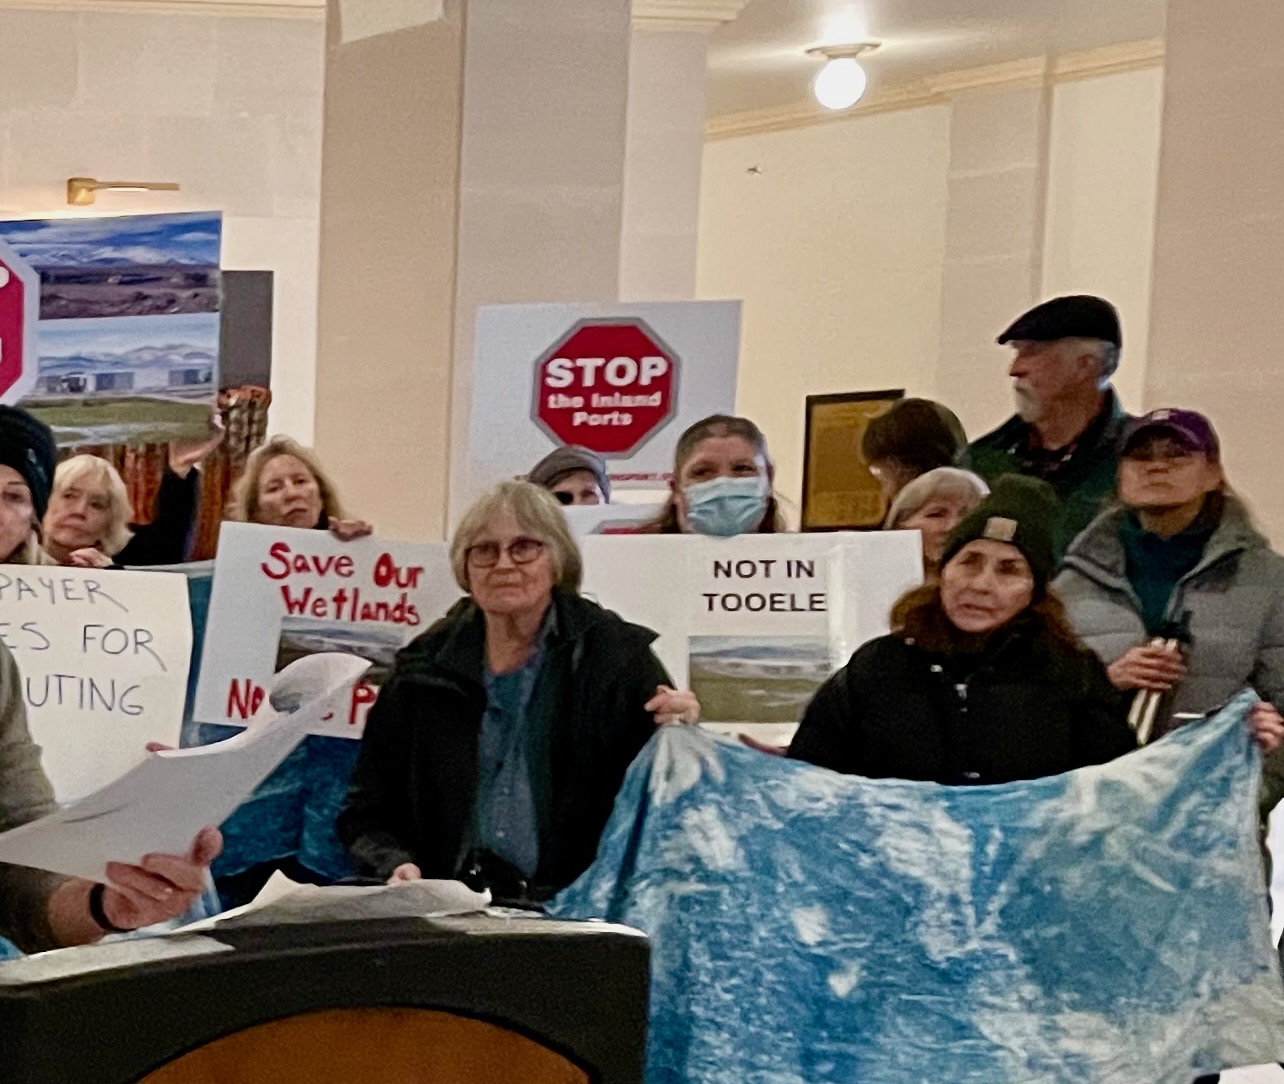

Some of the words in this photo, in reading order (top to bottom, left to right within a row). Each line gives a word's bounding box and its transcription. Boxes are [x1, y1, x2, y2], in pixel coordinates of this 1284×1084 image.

[544, 357, 667, 388] STOP
[547, 393, 584, 408] the
[591, 392, 661, 408] Inland
[572, 410, 632, 426] Ports
[261, 542, 354, 580] Save
[373, 553, 424, 589] Our
[713, 559, 775, 579] NOT
[786, 559, 815, 579] IN
[281, 585, 420, 626] Wetlands
[702, 593, 827, 613] TOOELE
[82, 624, 167, 672] FOR
